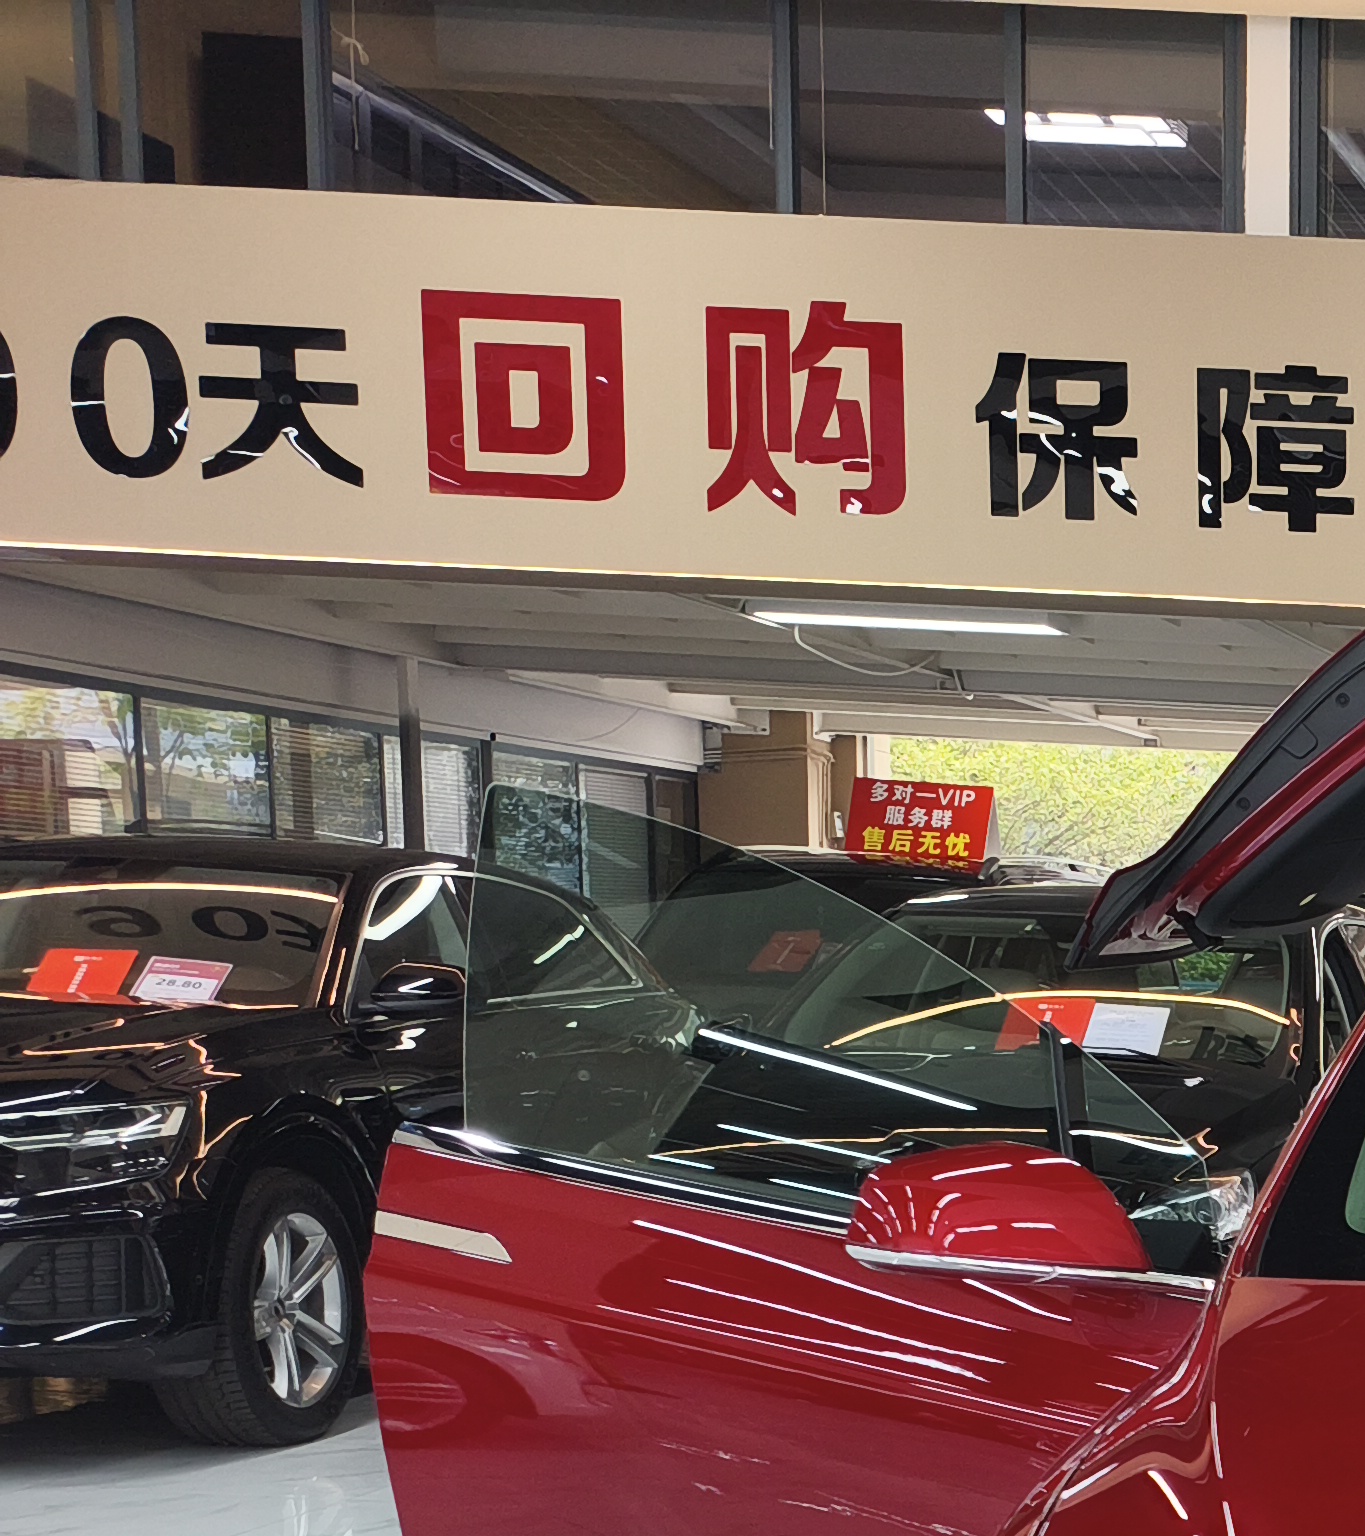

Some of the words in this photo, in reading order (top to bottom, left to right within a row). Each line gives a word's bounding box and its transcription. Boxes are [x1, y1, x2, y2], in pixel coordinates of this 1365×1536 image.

[869, 782, 976, 808] 多对一VIP
[884, 805, 954, 830] 服务群
[862, 826, 971, 858] 售后无忧
